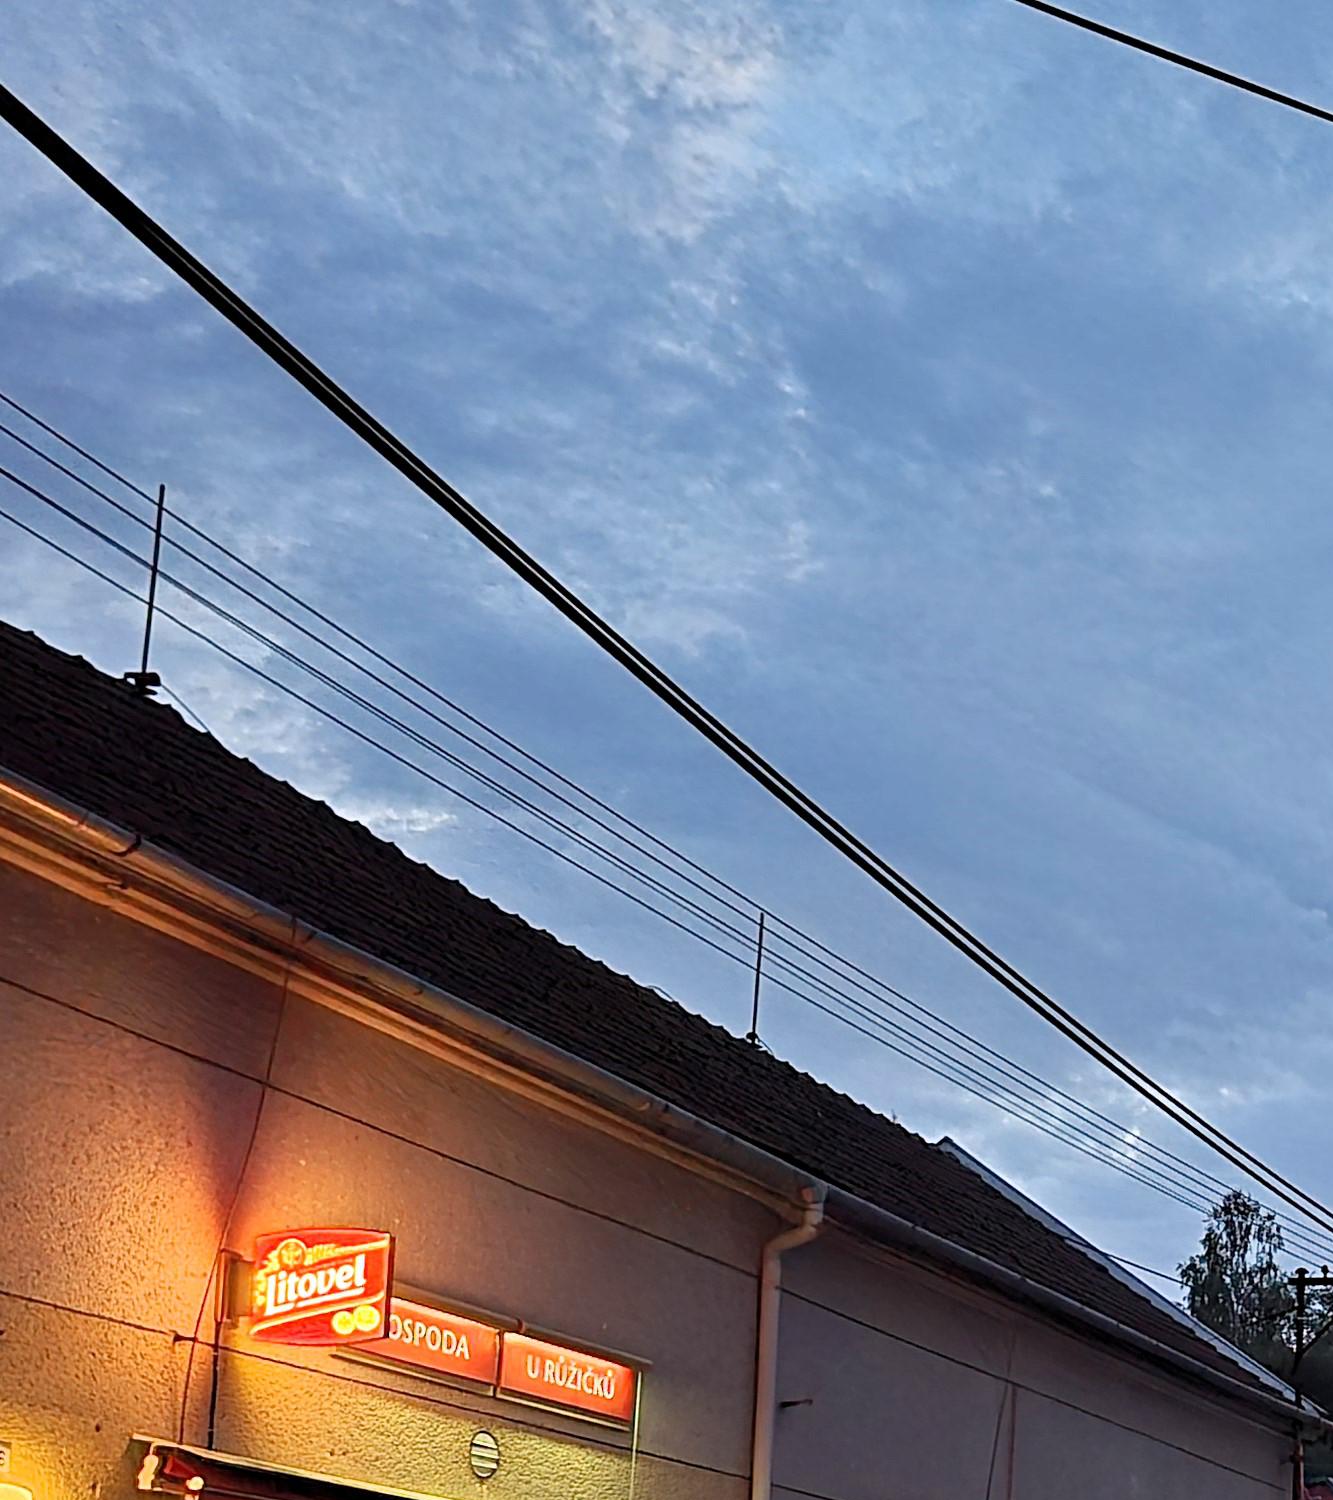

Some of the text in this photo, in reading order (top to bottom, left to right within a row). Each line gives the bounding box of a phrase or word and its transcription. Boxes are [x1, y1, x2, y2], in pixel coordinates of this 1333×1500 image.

[264, 1253, 367, 1317] Litovel
[388, 1313, 616, 1400] OSPODA U RŮŽIČKŮ
